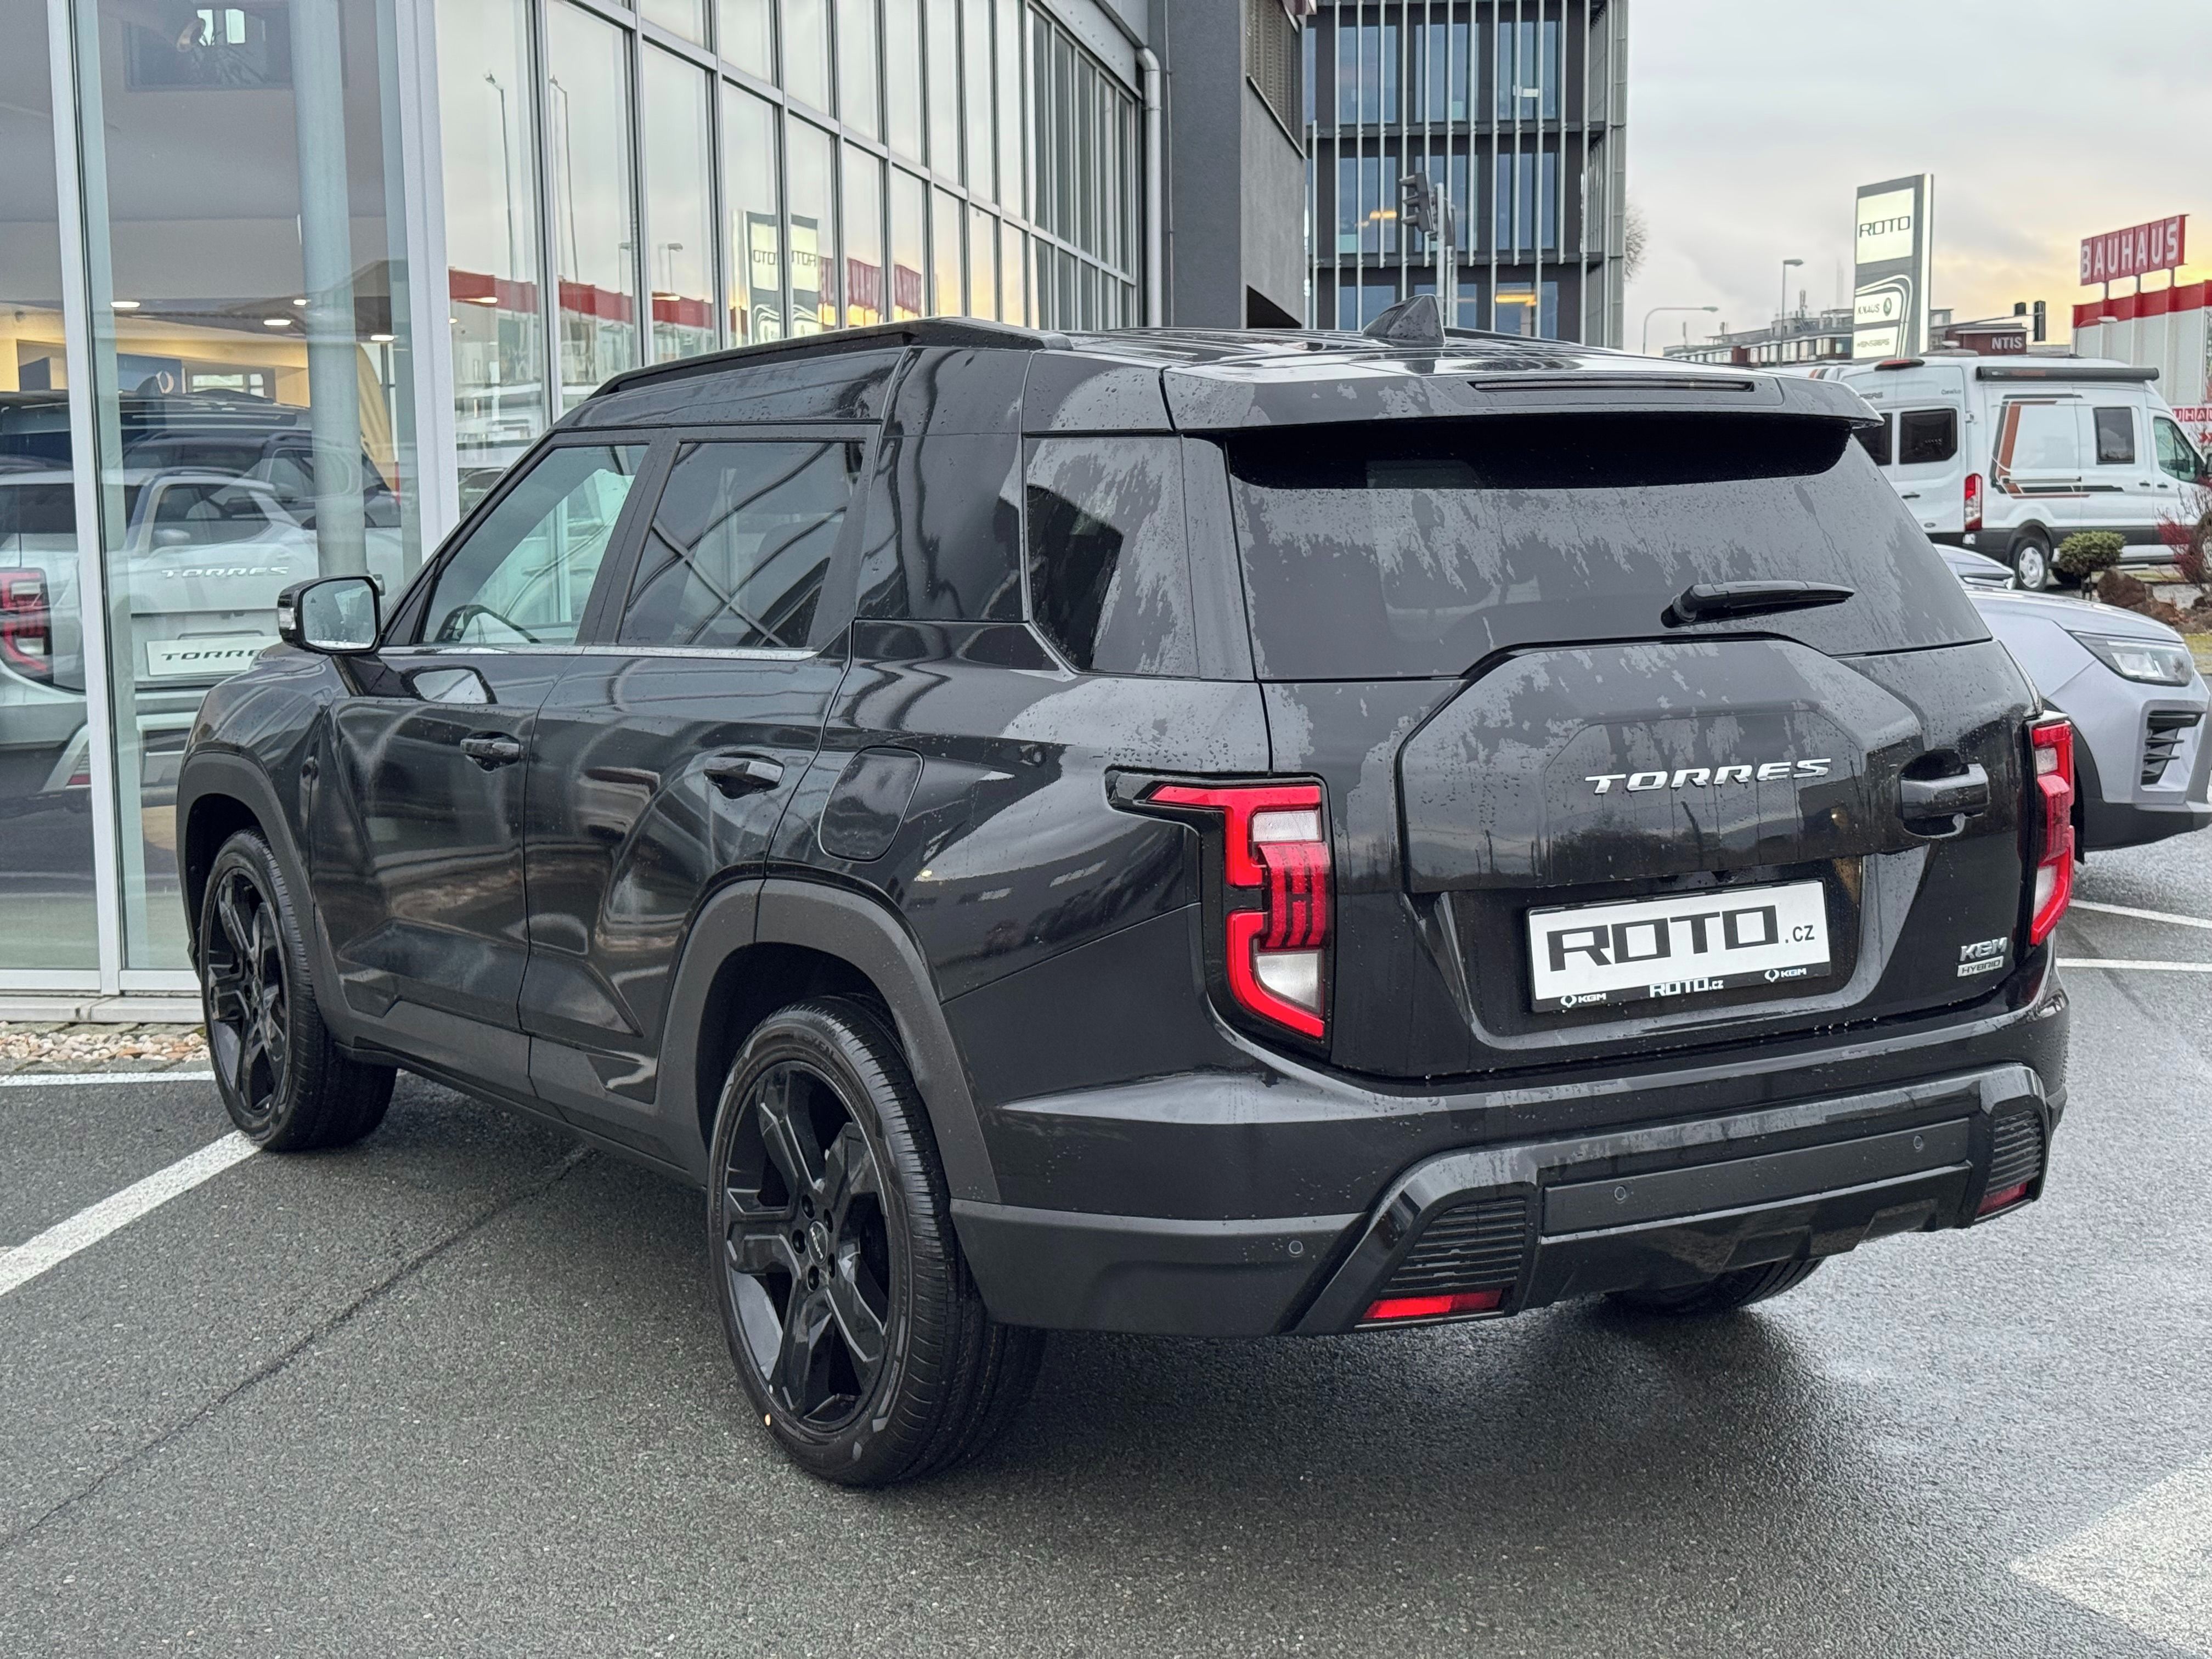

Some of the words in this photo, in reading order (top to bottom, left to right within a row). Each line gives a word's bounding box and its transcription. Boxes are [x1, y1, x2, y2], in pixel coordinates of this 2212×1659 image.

[1859, 216, 1910, 238] ROTO
[2081, 223, 2178, 279] BAUHAUS
[1991, 336, 2023, 350] NTIS
[161, 566, 289, 577] TORRES
[1584, 758, 1831, 794] TORRES
[1959, 936, 2007, 962] KGM
[1781, 968, 1807, 978] KGM
[1961, 960, 2001, 974] HYBRID
[1578, 993, 1606, 1003] KGM
